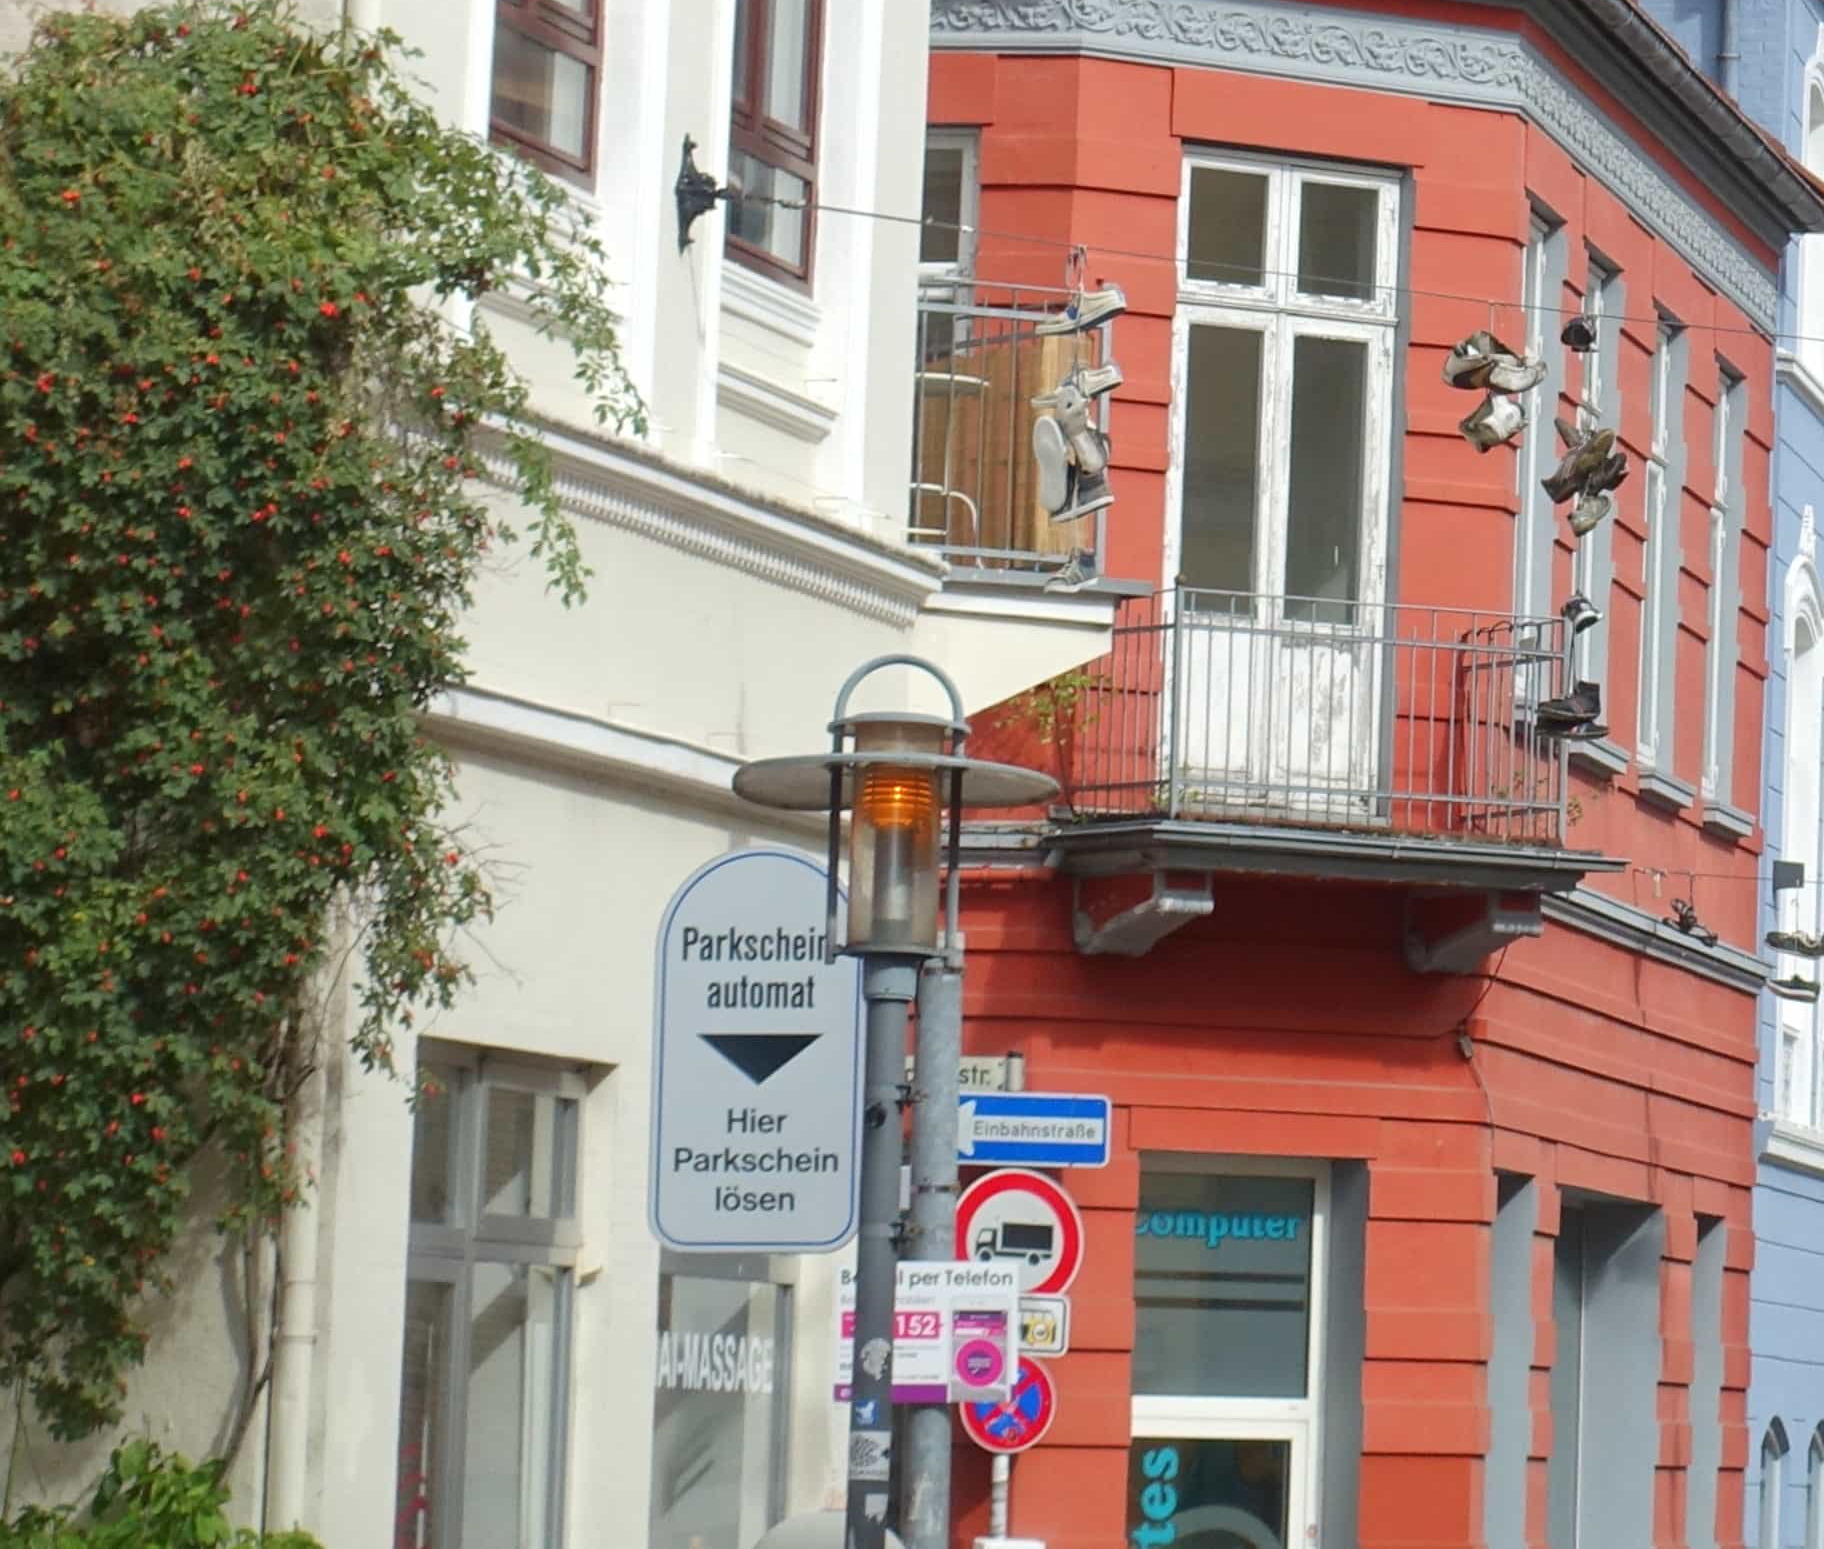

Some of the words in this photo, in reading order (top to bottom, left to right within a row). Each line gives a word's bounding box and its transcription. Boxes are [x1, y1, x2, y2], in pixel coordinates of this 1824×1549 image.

[707, 975, 816, 1009] automat
[726, 1108, 788, 1134] Hier
[973, 1121, 1096, 1140] Einbahnstraße
[672, 1147, 839, 1173] Parkschein
[714, 1186, 796, 1212] lösen
[908, 1272, 940, 1288] per
[944, 1269, 1014, 1286] Telefon
